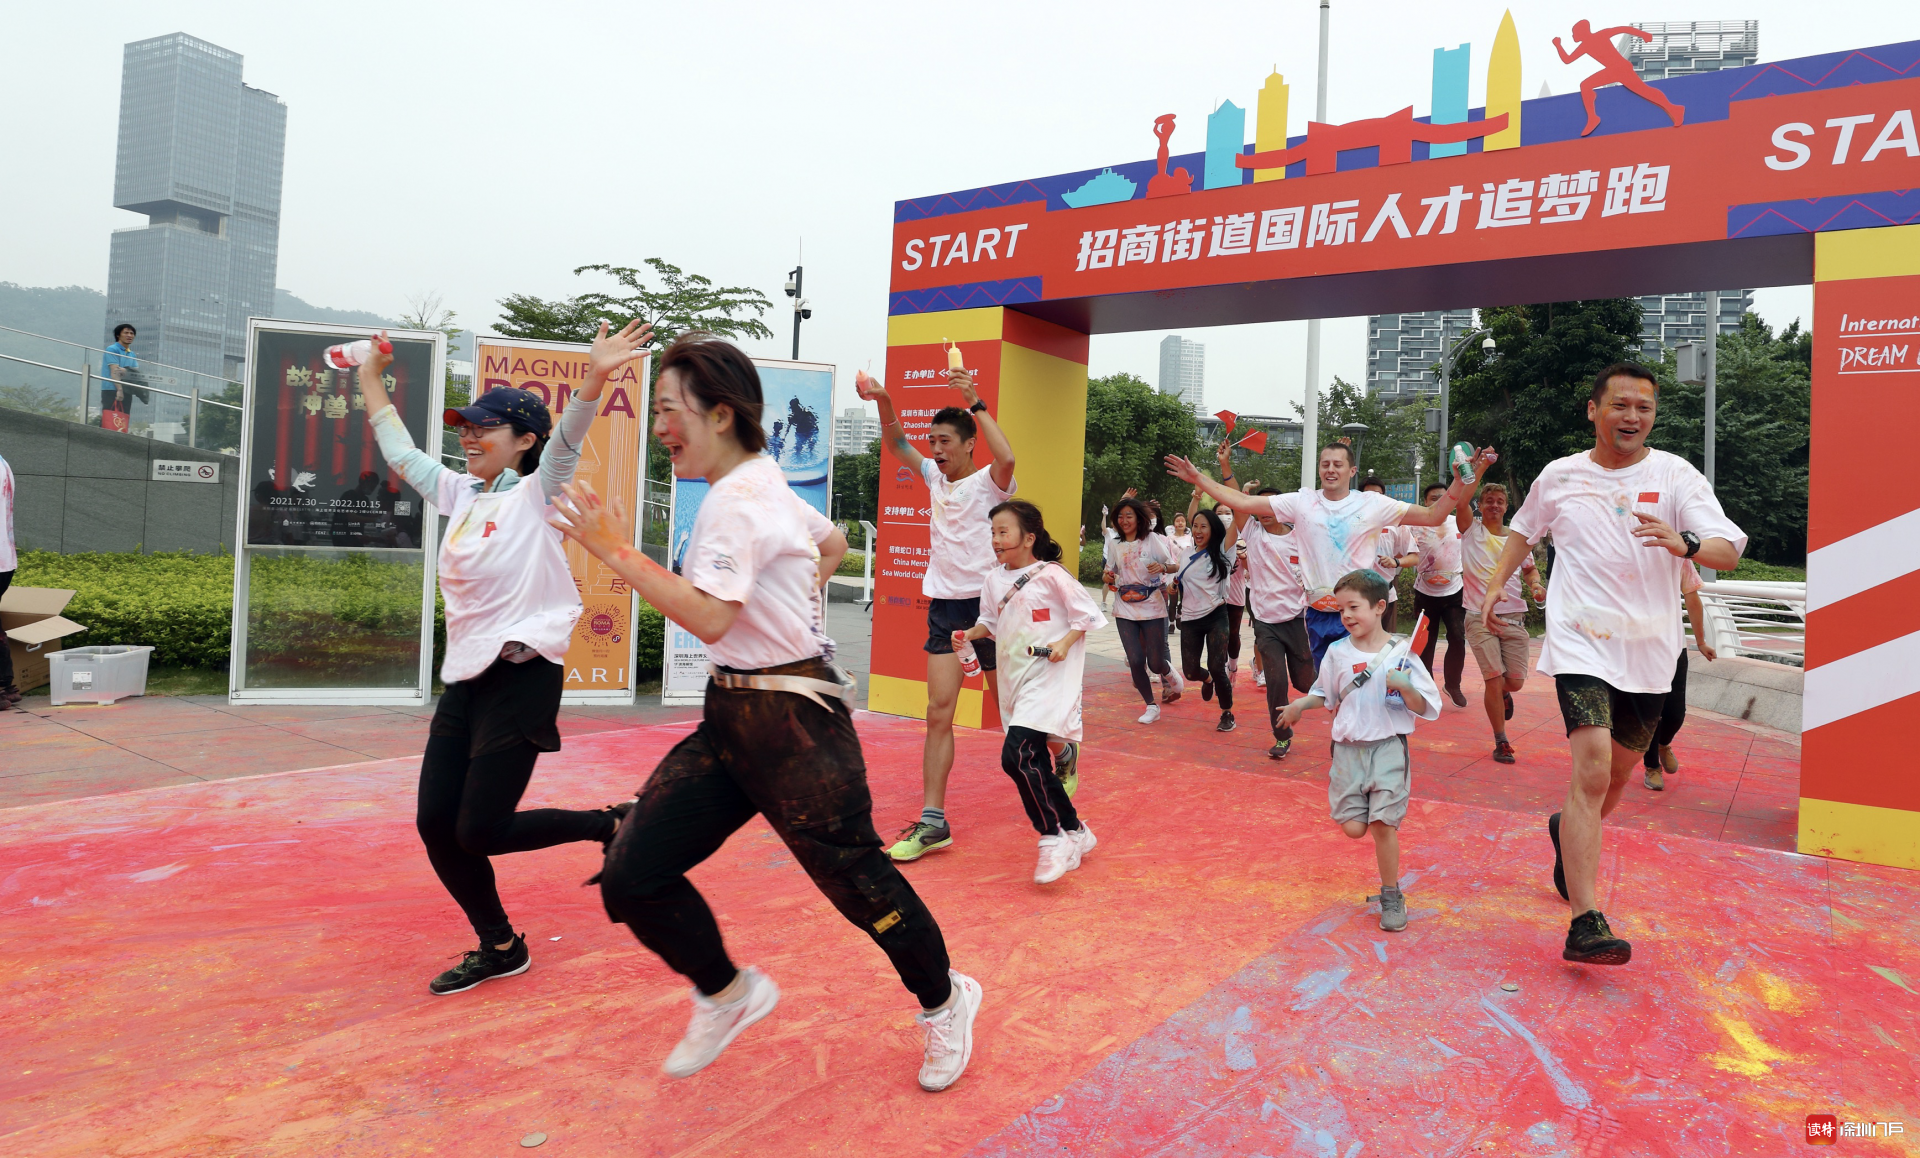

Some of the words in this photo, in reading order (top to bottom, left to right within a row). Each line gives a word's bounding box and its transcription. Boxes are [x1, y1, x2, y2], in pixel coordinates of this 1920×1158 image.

[1764, 109, 1920, 171] STA
[1075, 163, 1670, 271] 招商街道国际人才追梦跑
[902, 223, 1028, 271] START
[1838, 344, 1908, 371] DREAM
[485, 356, 638, 383] MAGNIFCA
[904, 369, 935, 379] 主办单位
[158, 464, 191, 472] 禁止攀爬
[270, 497, 316, 507] 2021.7.30
[329, 499, 381, 509] 2022.10.15
[884, 506, 914, 516] 支持单位
[889, 546, 911, 555] 招商蛇口
[893, 558, 909, 566] China
[893, 570, 910, 578] World
